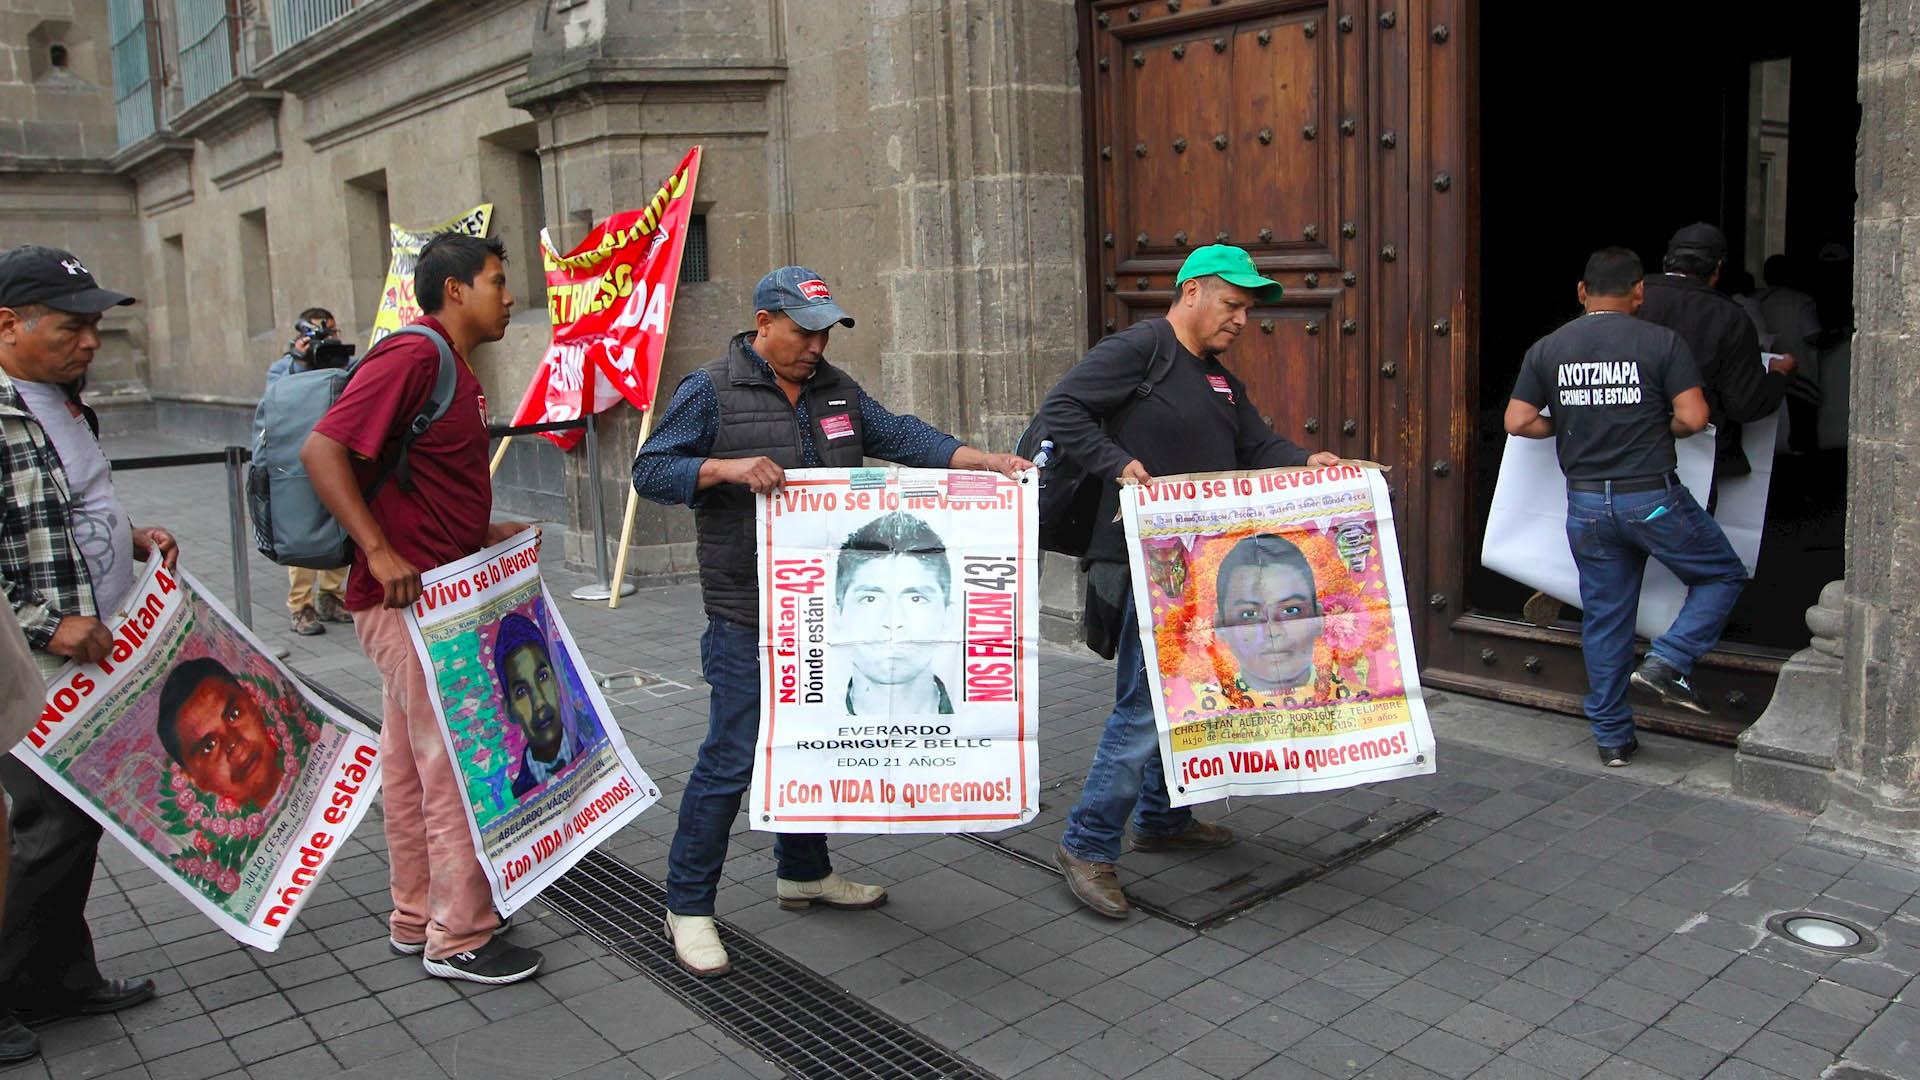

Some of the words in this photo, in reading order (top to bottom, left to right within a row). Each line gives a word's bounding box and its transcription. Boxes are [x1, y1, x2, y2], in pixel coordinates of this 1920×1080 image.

[1558, 361, 1640, 387] AYOTZINAPA
[1560, 389, 1591, 406] CRIMEN
[1592, 388, 1604, 405] DE
[1604, 386, 1641, 405] ESTADO
[776, 488, 837, 517] ¡Vivo
[844, 492, 870, 511] se
[879, 488, 900, 511] lo
[1202, 480, 1227, 499] se
[1232, 477, 1252, 496] lo
[472, 570, 489, 592] se
[487, 563, 501, 585] lo
[498, 546, 539, 579] llevaro
[774, 558, 825, 594] 43!
[964, 556, 1017, 591] 43!
[778, 596, 795, 657] faltan
[803, 597, 824, 643] están
[968, 592, 1013, 657] FALTAN
[779, 664, 796, 703] Nos
[804, 648, 824, 703] Dónde
[967, 663, 1013, 702] NOS
[797, 739, 918, 750] RODRIGUEZ
[838, 725, 951, 737] EVERARDO
[1174, 719, 1234, 736] CHRISTIAN
[1182, 737, 1202, 746] Hijo
[1207, 734, 1217, 742] de
[1221, 730, 1260, 740] Clemente
[1377, 713, 1399, 723] años
[837, 757, 879, 767] EDAD
[883, 757, 900, 767] 21
[908, 756, 956, 767] AÑOS
[1182, 756, 1224, 785] ¡Con
[1228, 749, 1279, 773] VIDA
[1283, 747, 1300, 770] lo
[1304, 731, 1409, 773] queremos!
[323, 744, 378, 825] están
[778, 780, 823, 808] ¡Con
[829, 779, 875, 803] VIDA
[880, 778, 896, 804] lo
[902, 777, 1012, 809] queremos!
[499, 806, 543, 841] ABELARDO
[502, 854, 532, 891] ¡Con
[531, 829, 563, 864] VIDA
[563, 822, 574, 843] lo
[573, 776, 634, 835] queremos!
[242, 856, 266, 889] JULIO
